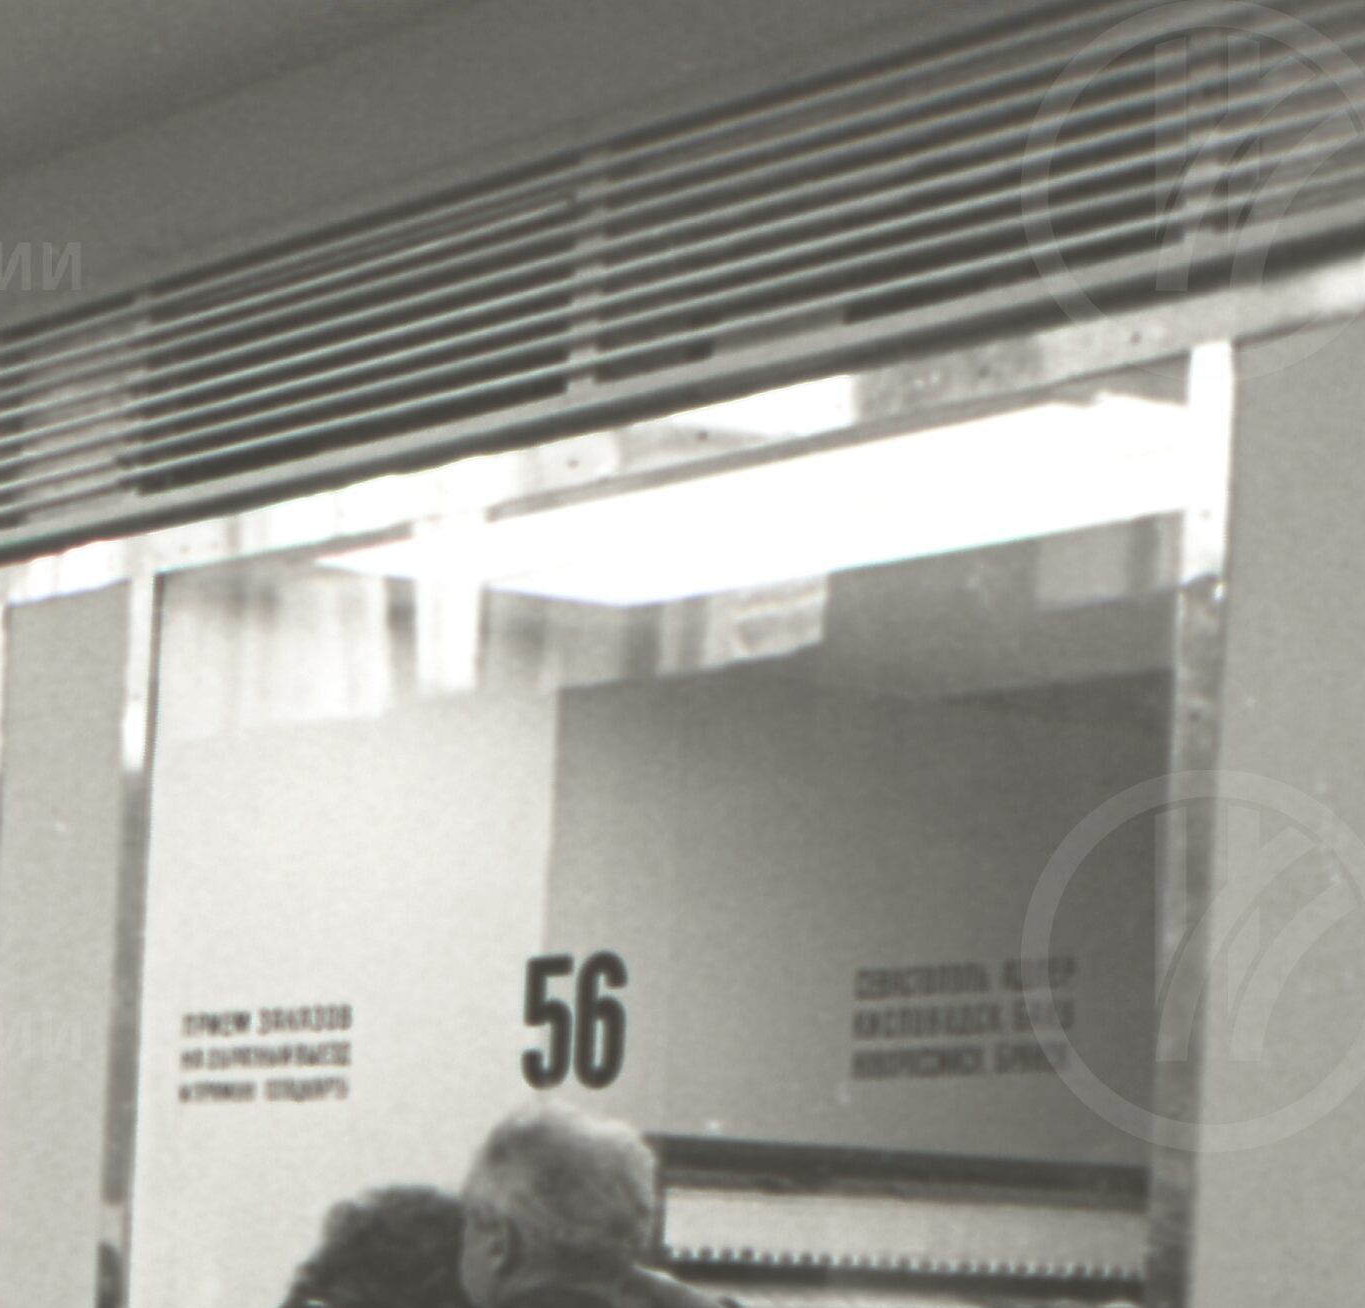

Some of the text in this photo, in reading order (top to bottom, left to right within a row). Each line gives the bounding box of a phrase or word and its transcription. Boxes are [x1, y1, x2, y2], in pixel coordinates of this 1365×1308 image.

[182, 1002, 353, 1037] ПРИЕМ ЗАКАЗОВ
[520, 950, 628, 1091] 56
